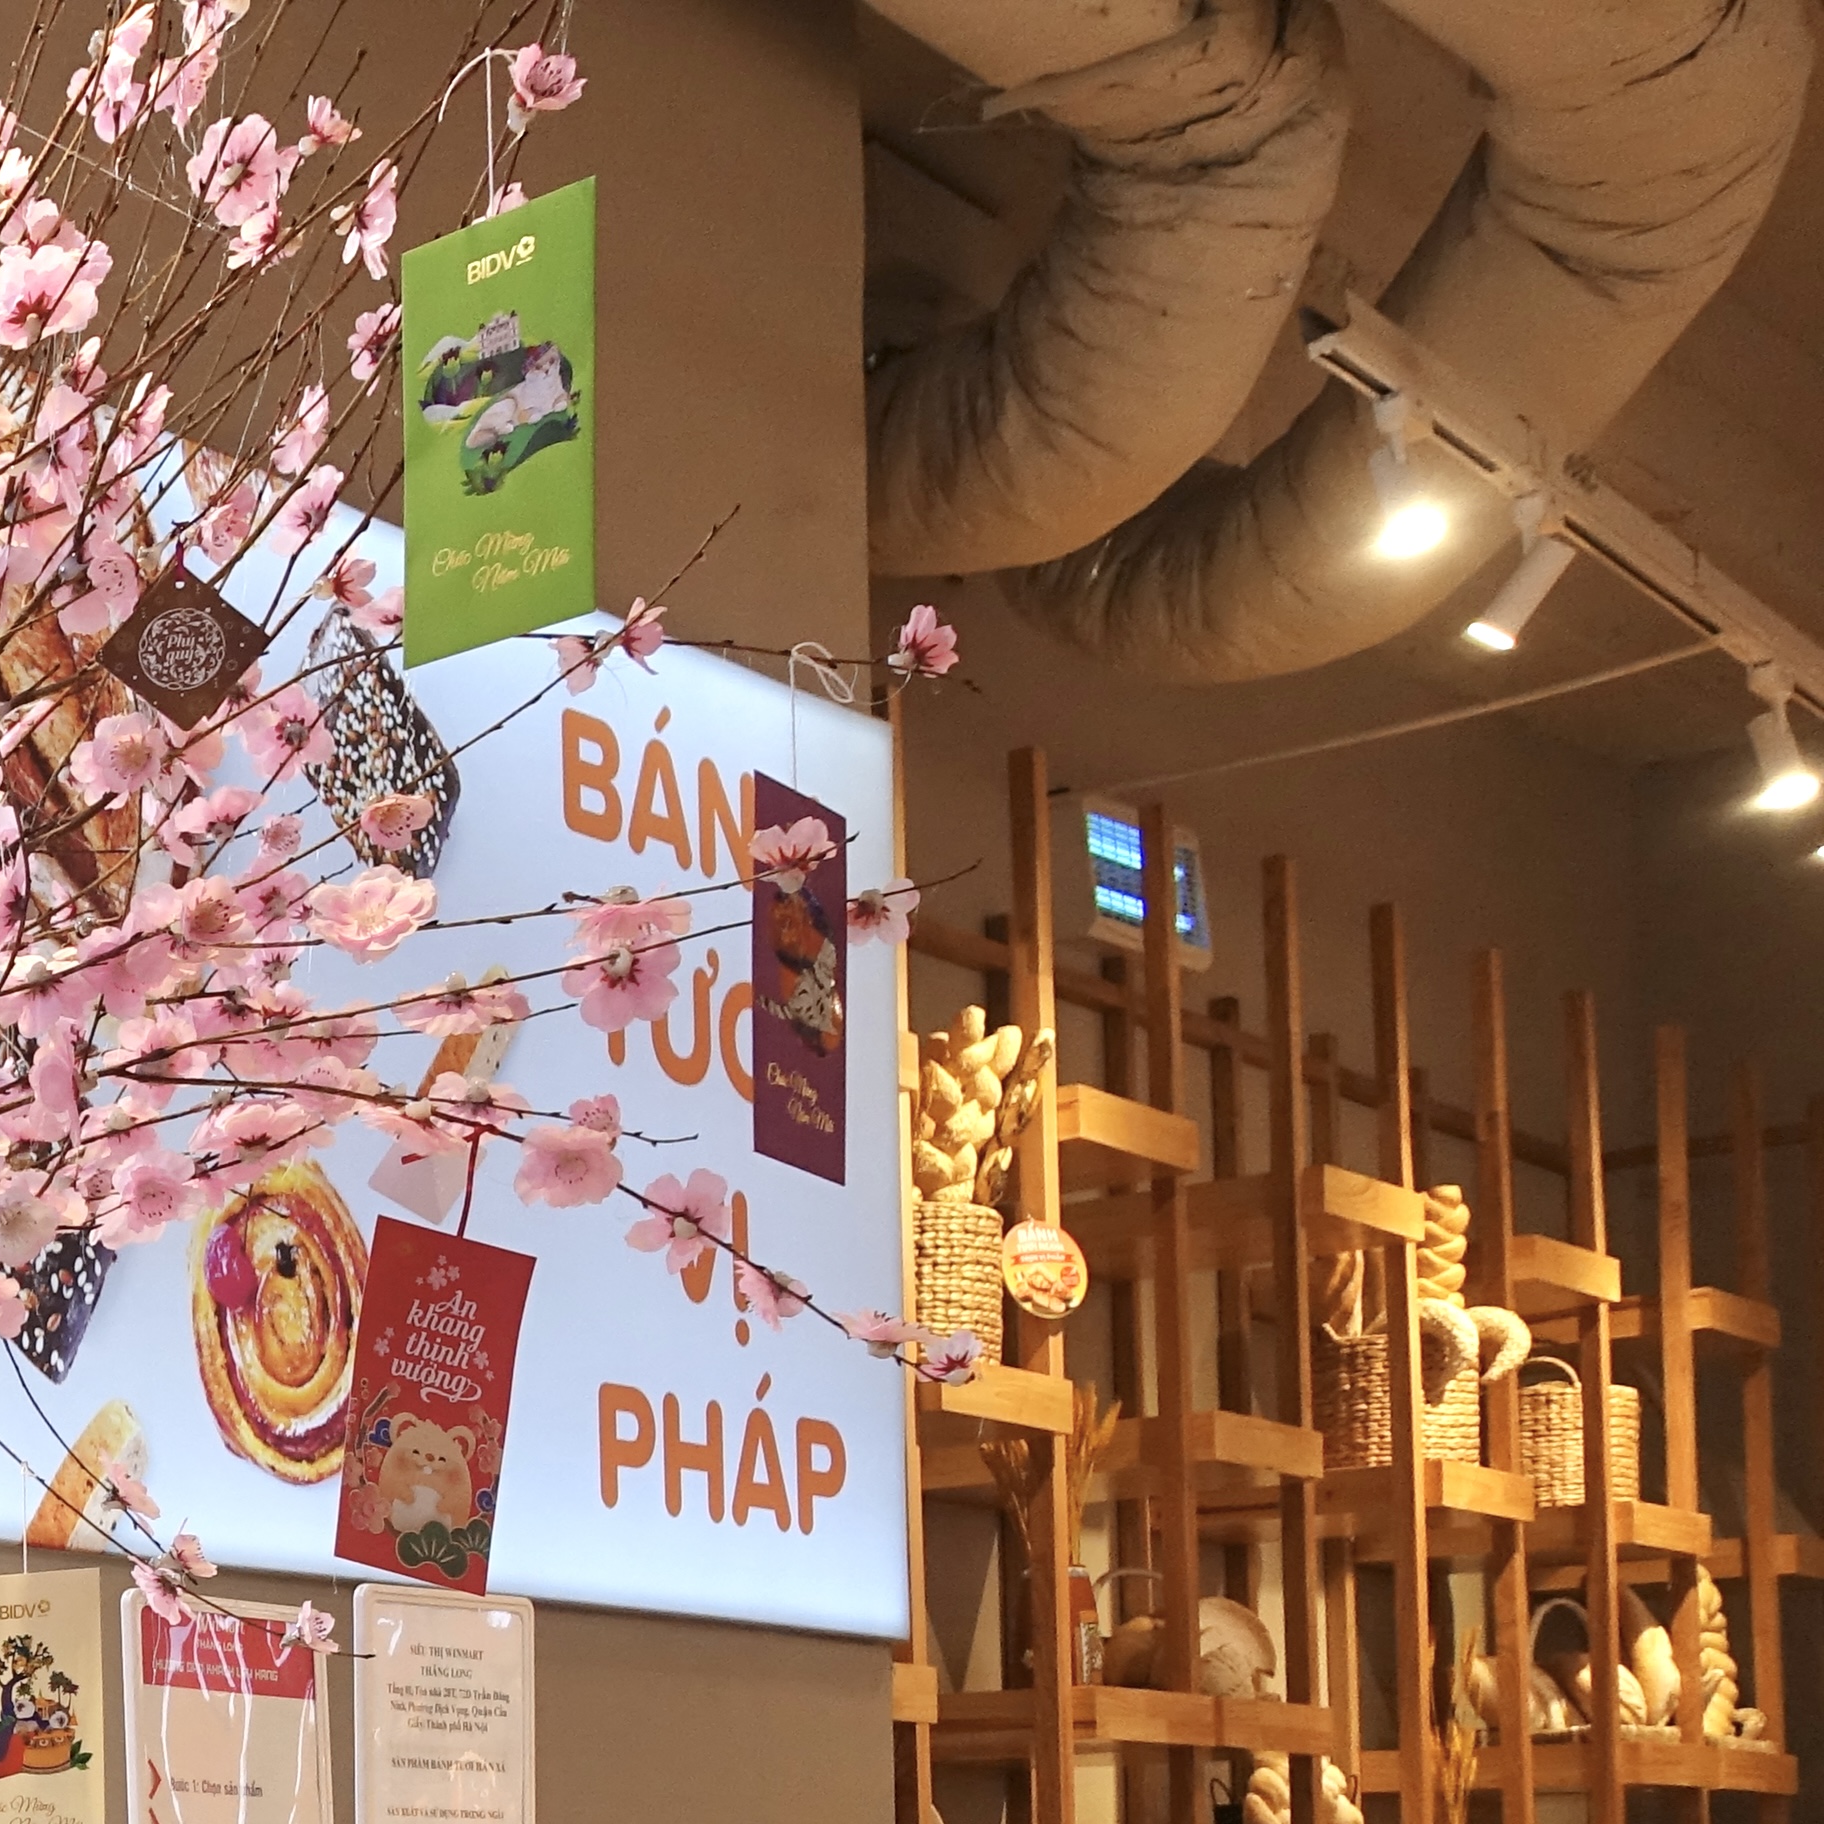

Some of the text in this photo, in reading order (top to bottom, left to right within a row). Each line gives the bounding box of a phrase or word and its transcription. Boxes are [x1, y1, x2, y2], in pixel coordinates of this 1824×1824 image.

[466, 246, 518, 286] BIDV
[560, 706, 755, 893] BÁN
[406, 1298, 486, 1353] khang
[434, 1289, 477, 1320] An
[391, 1357, 483, 1403] vượng
[597, 1370, 847, 1536] PHÁP
[0, 1602, 37, 1621] BIDV
